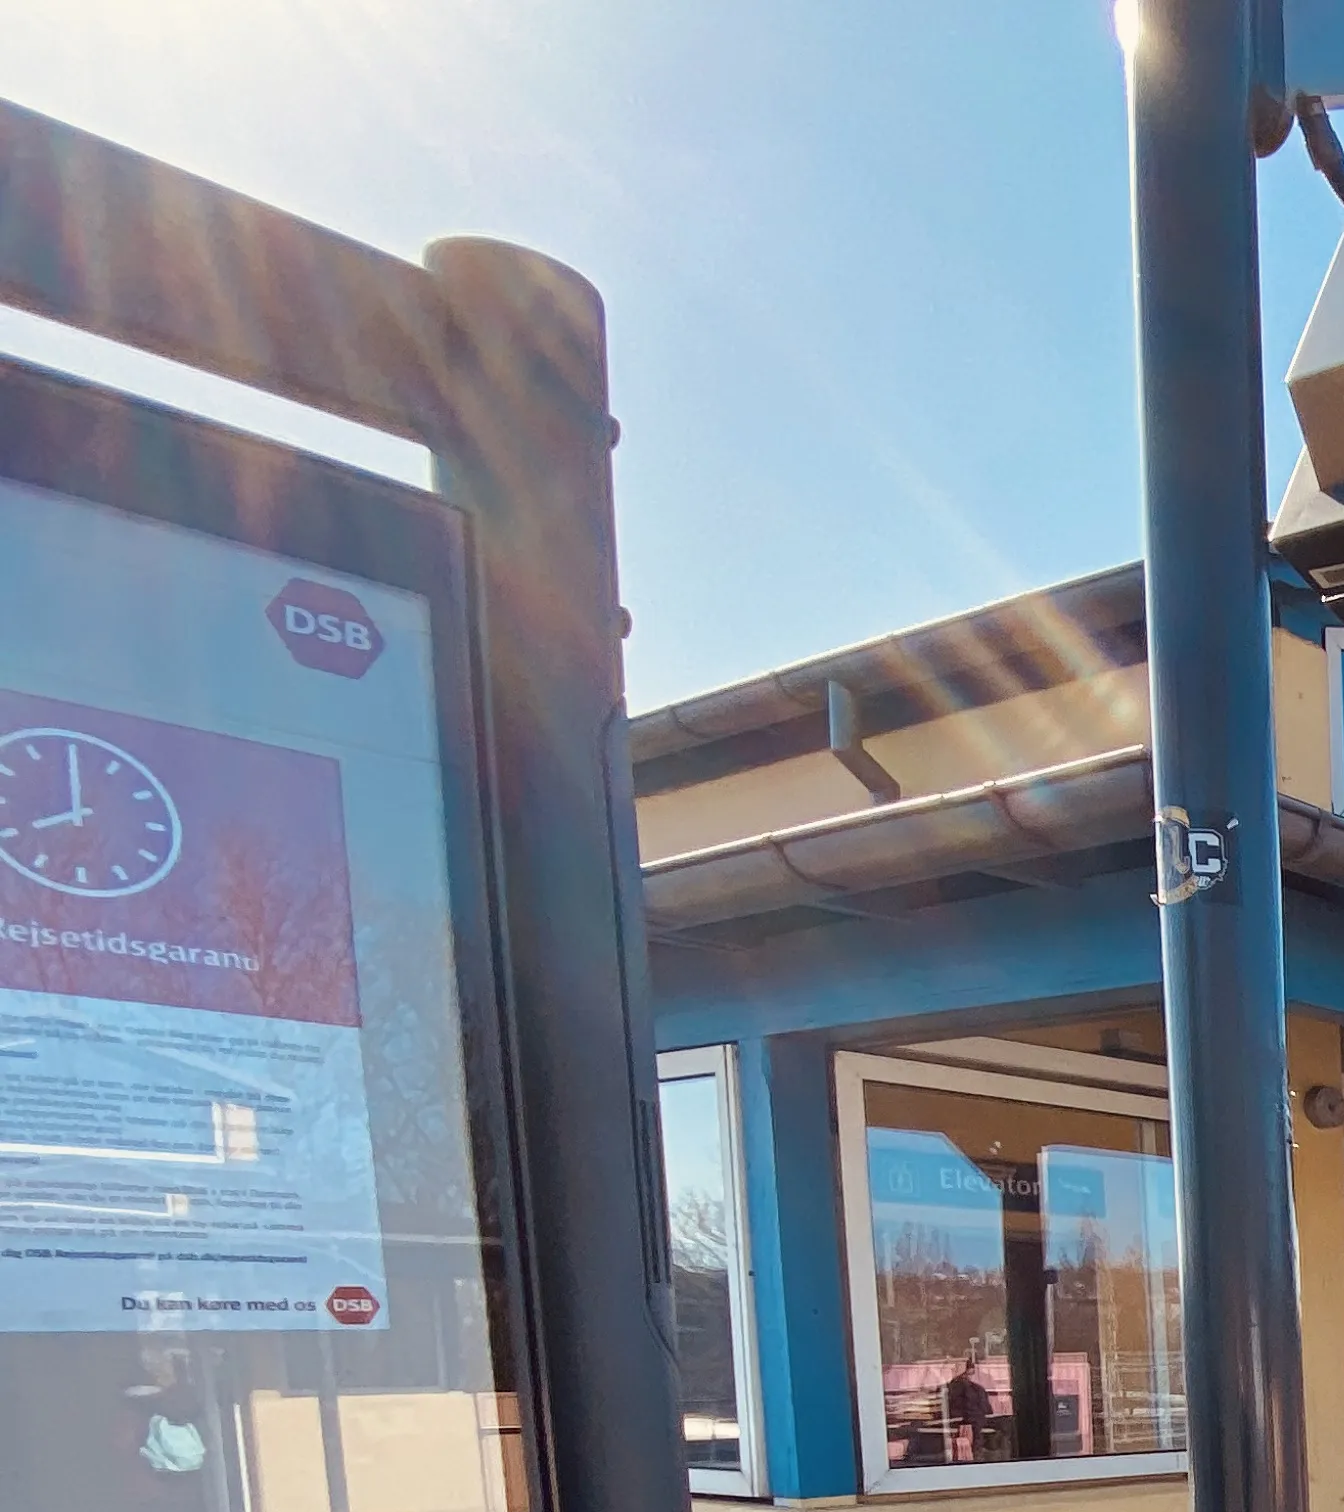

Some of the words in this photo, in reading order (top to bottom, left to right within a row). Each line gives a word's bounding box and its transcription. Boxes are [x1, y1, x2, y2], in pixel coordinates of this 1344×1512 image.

[284, 604, 372, 650] DSB
[121, 1296, 149, 1311] Du
[156, 1297, 192, 1311] kan
[247, 1296, 289, 1312] med
[294, 1300, 317, 1312] os
[333, 1298, 373, 1312] DSB
